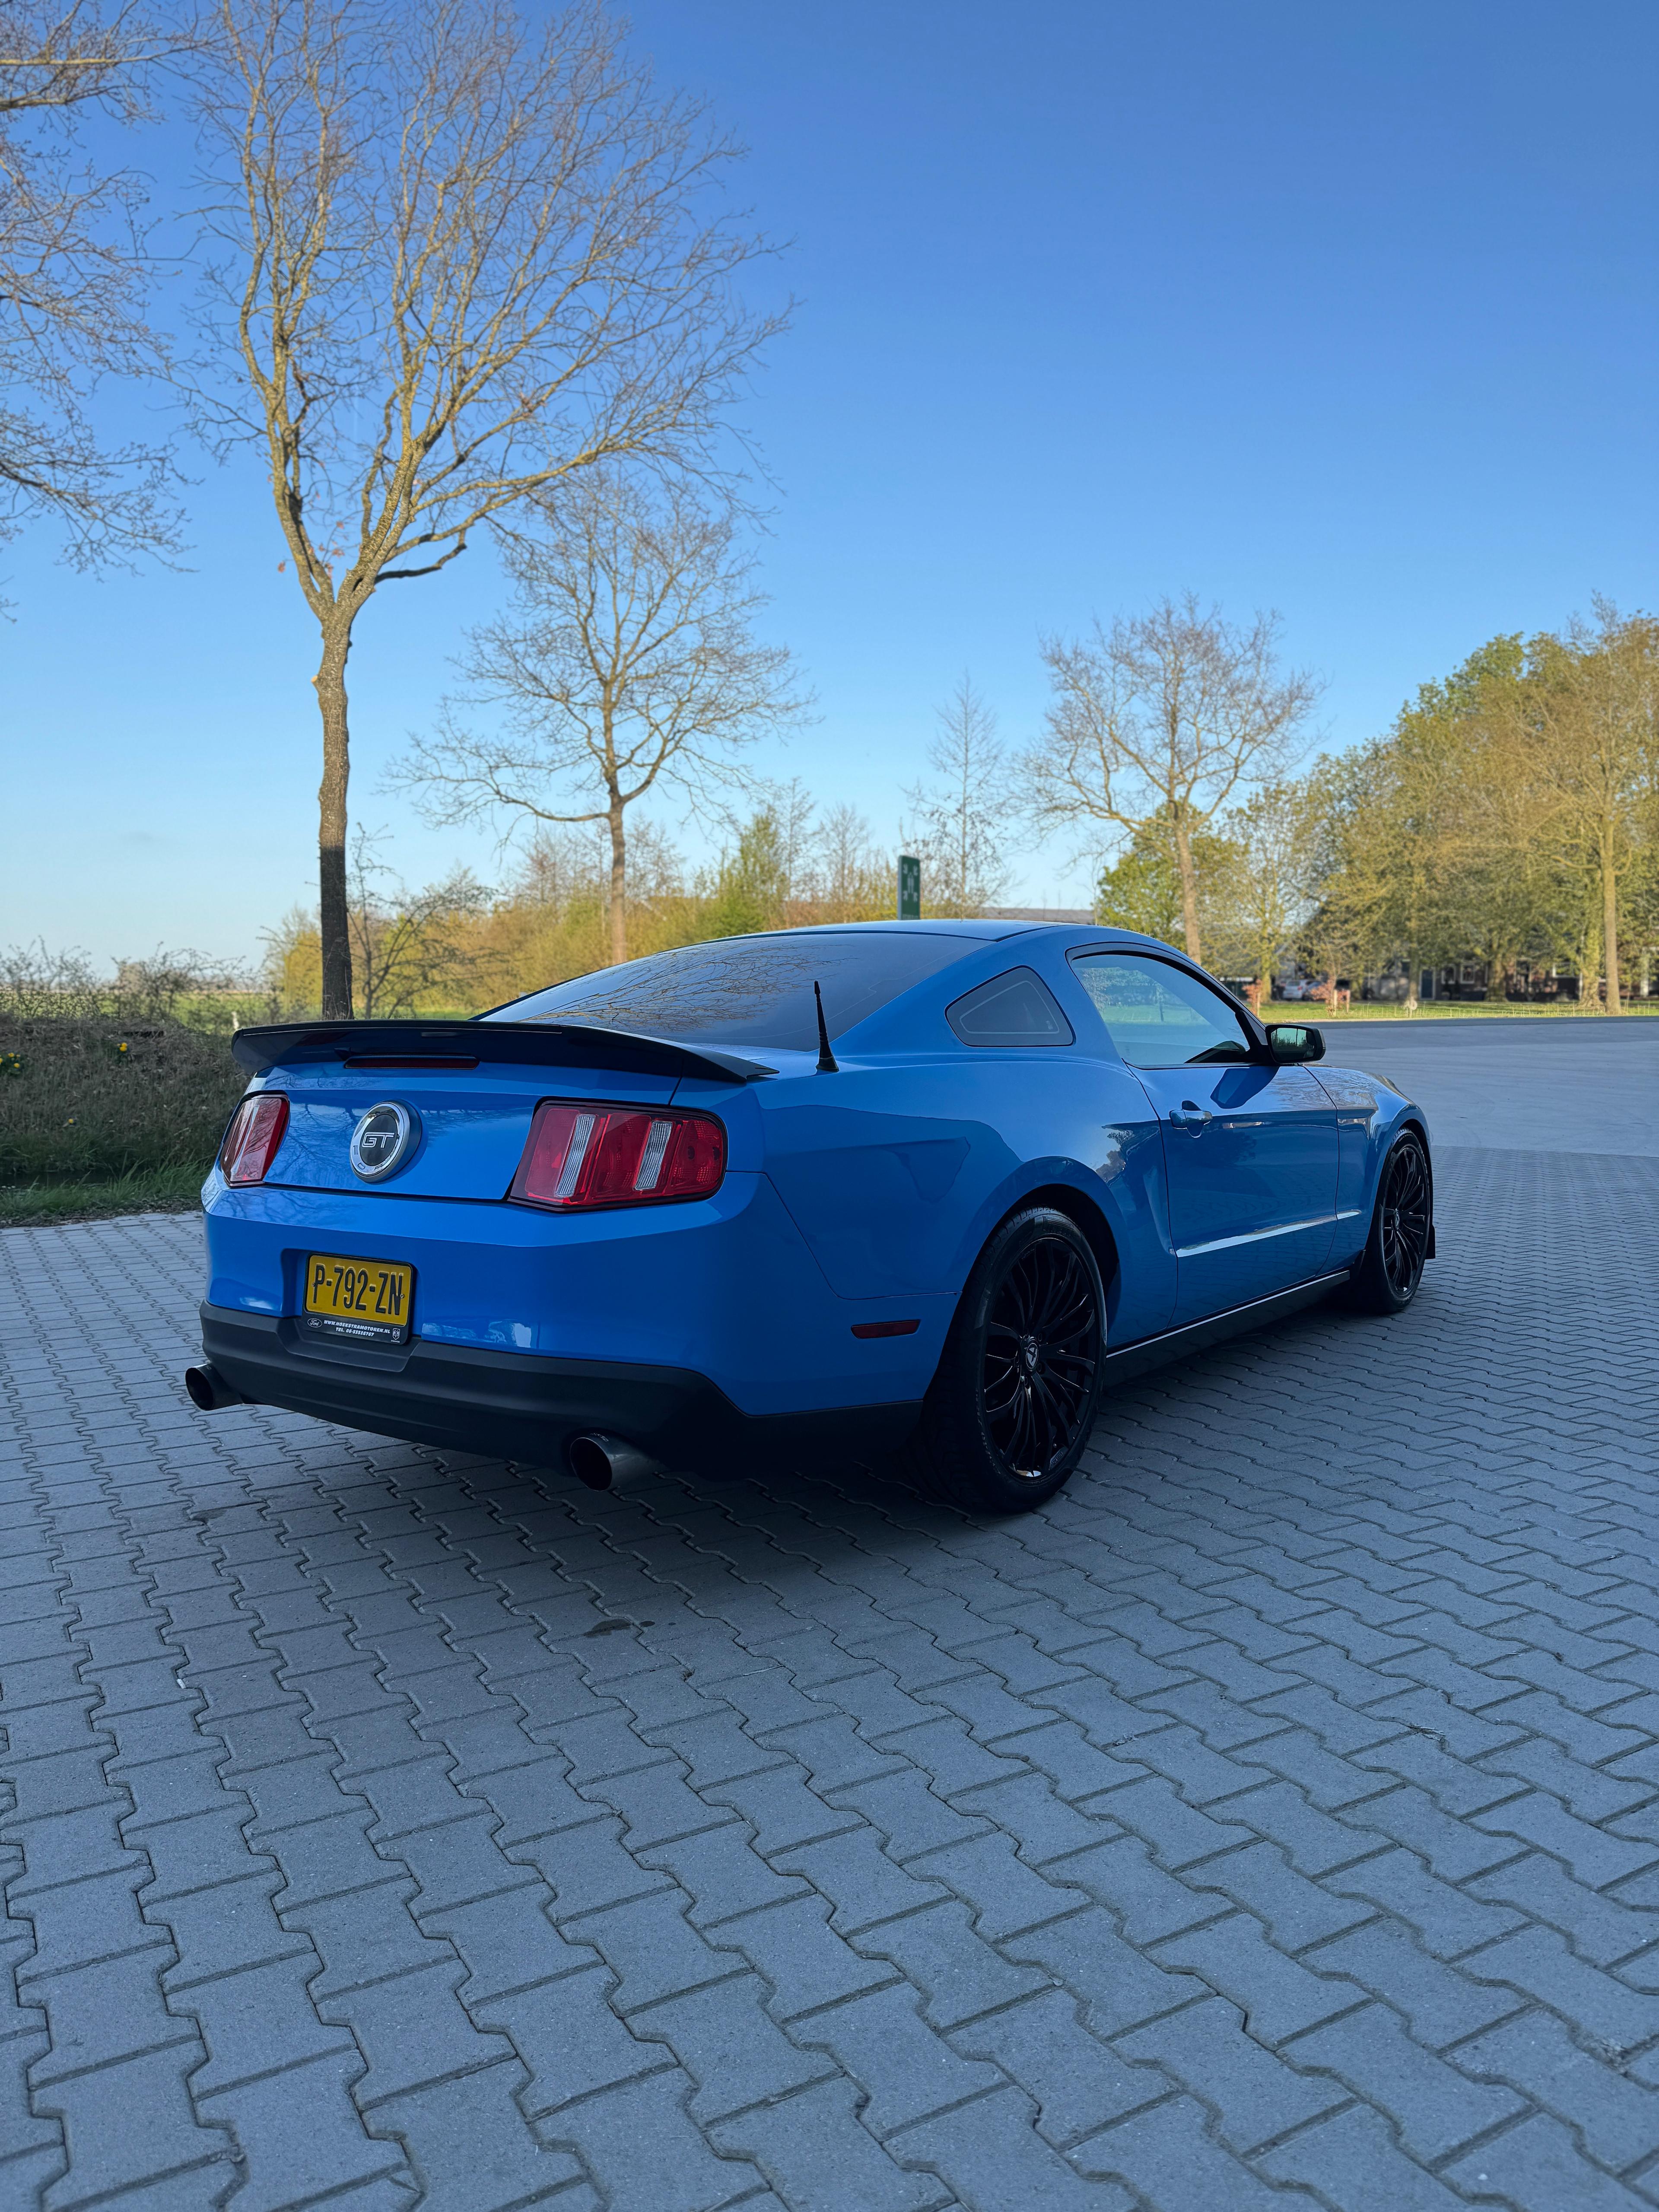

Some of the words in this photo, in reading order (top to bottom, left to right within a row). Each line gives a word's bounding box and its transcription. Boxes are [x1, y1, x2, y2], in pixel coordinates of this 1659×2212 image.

[362, 1131, 395, 1148] GT
[313, 1263, 403, 1316] P-792-ZN
[324, 1320, 391, 1334] WWW.HOEKSTRAMOTOREN.NL
